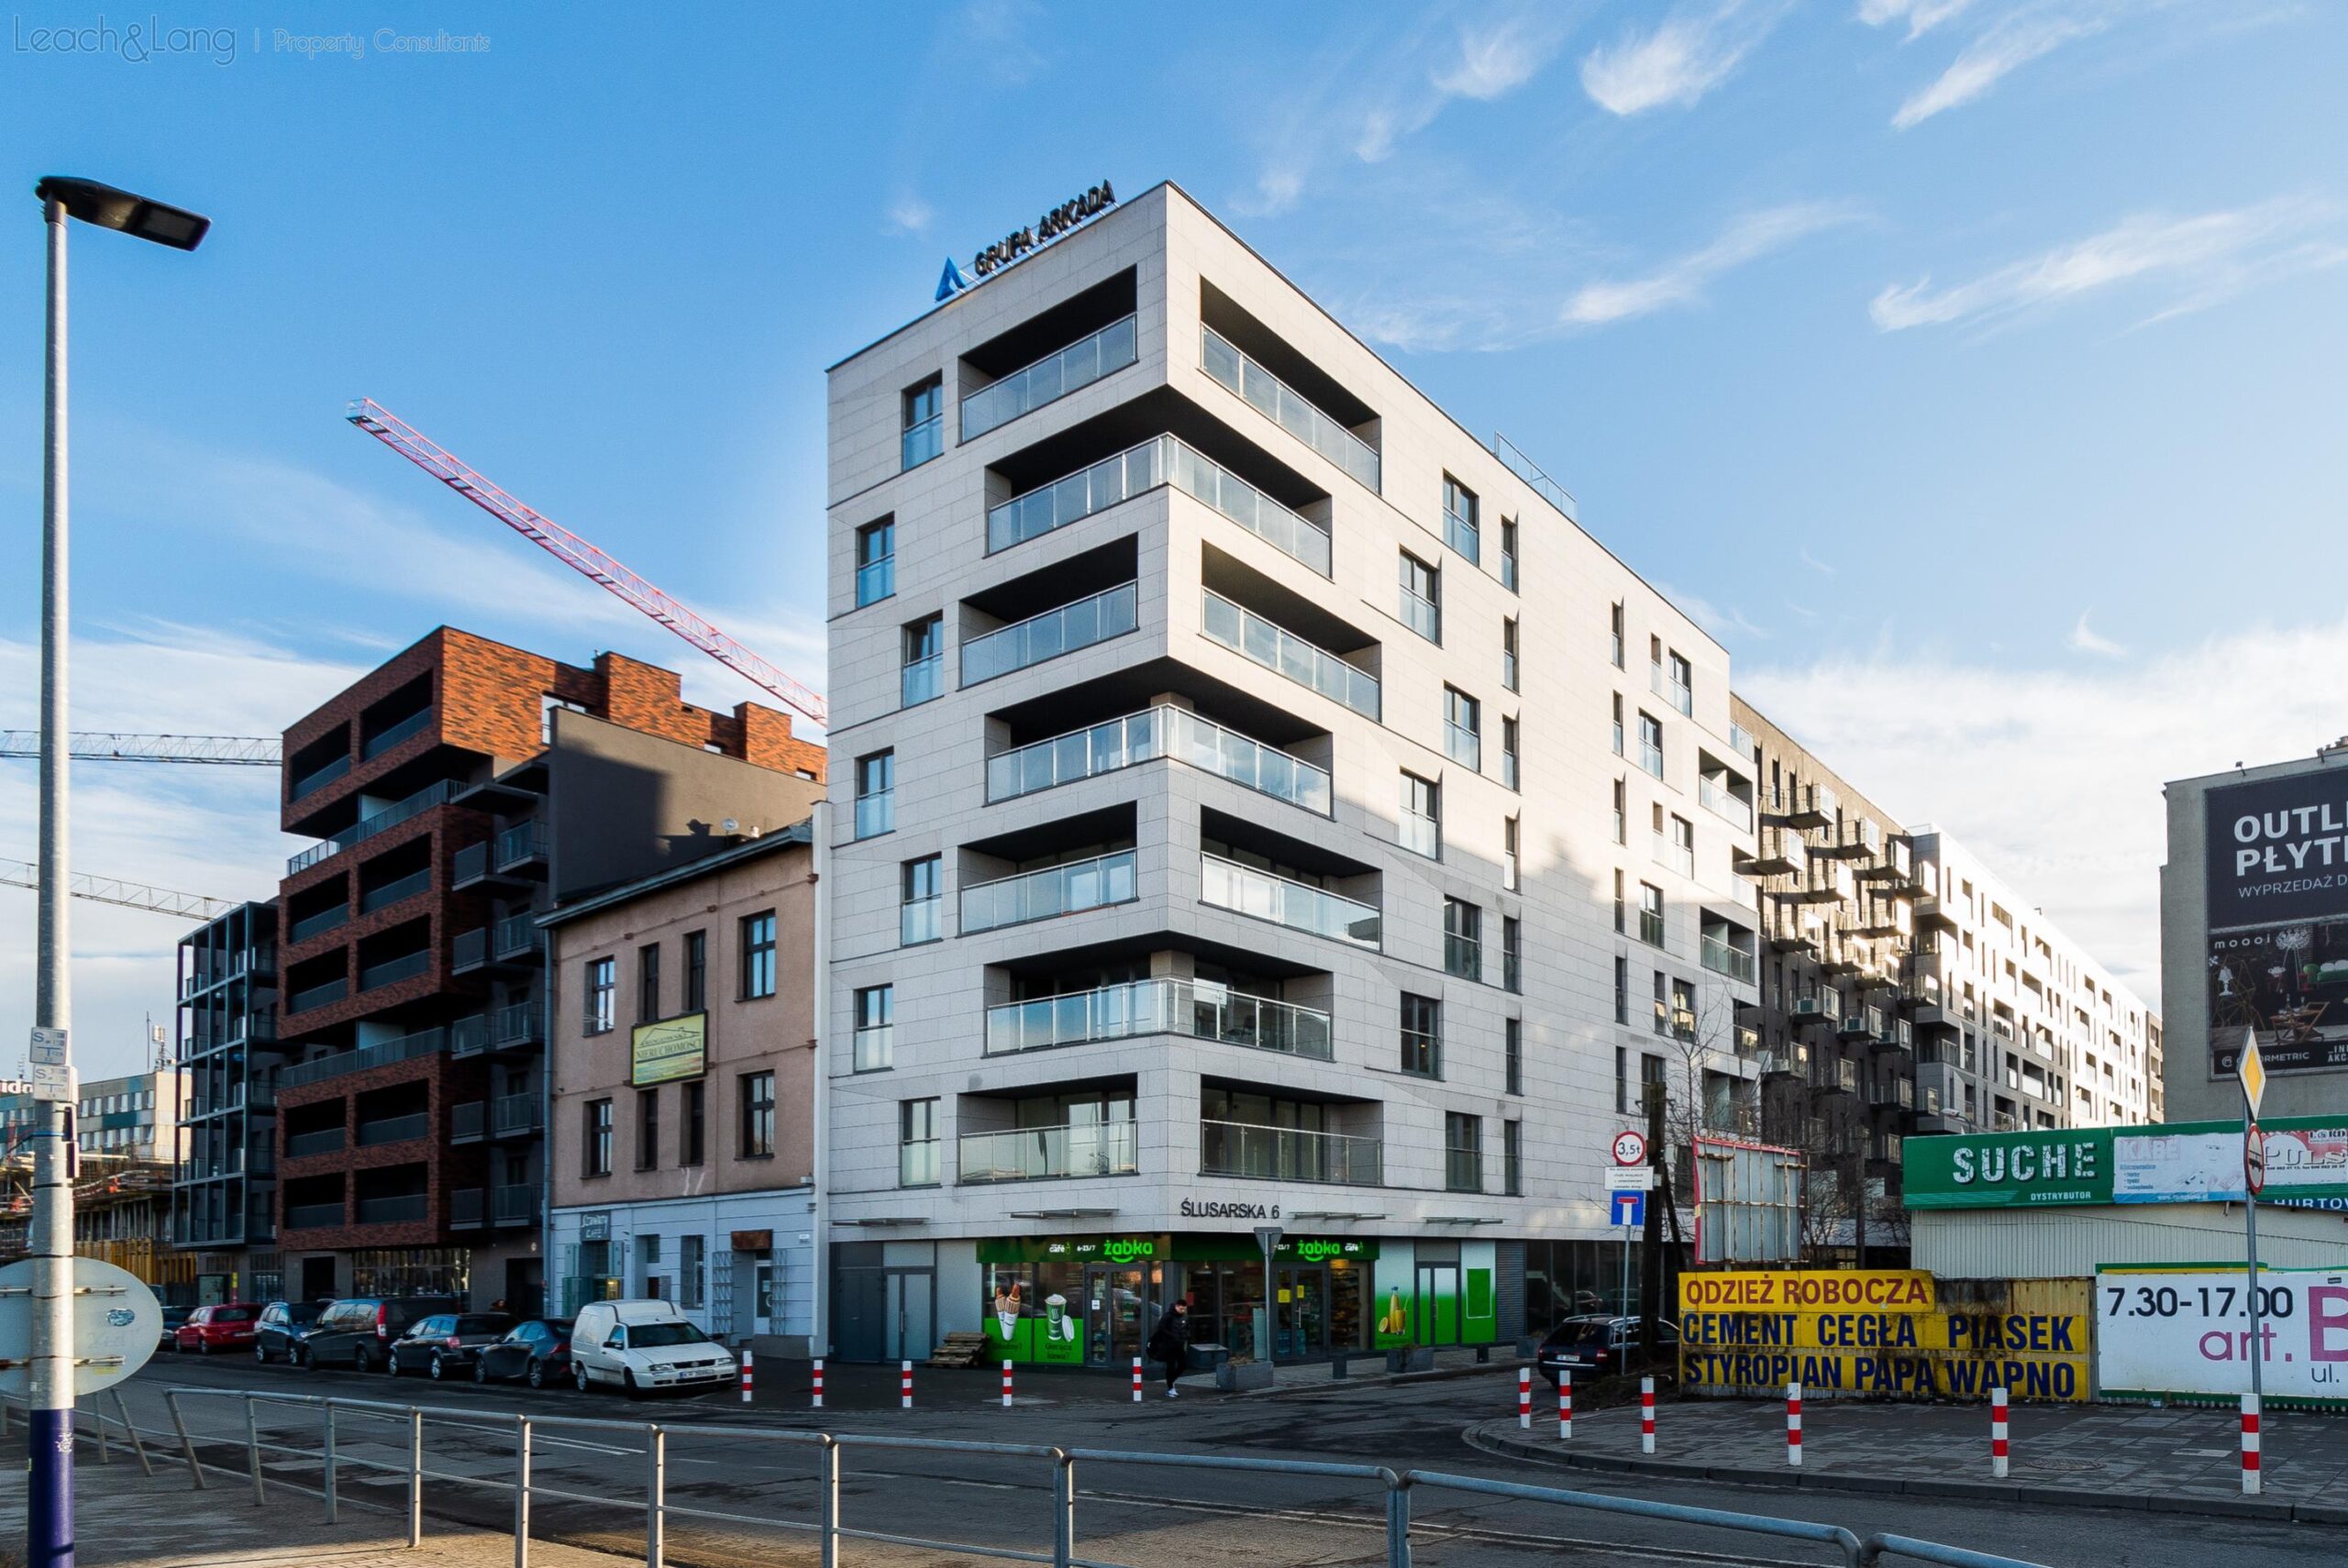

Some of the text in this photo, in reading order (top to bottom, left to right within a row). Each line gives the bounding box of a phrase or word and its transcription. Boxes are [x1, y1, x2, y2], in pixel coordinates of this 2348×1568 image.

[975, 179, 1116, 276] GRUPA ARKADA
[2234, 801, 2348, 843] OUTL
[2237, 835, 2348, 877] PŁYT
[2239, 874, 2333, 898] WYPRZEDAŻ
[1618, 1142, 1641, 1155] 3,5t
[1953, 1142, 2097, 1184] SUCHE
[1180, 1198, 1280, 1220] ŚLUSARSKA 6
[2031, 1191, 2091, 1201] DYSTRYBUTOR
[1103, 1239, 1153, 1255] żabka
[1297, 1240, 1341, 1254] żabka
[1686, 1274, 1928, 1306] ODZIEŻ ROBOCZA
[1682, 1313, 2075, 1353] CEMENT CEGŁA PIASEK
[2198, 1322, 2292, 1362] art.
[1684, 1353, 2076, 1397] STYROPIAN PAPA WAPNO
[2311, 1364, 2340, 1383] ul.
